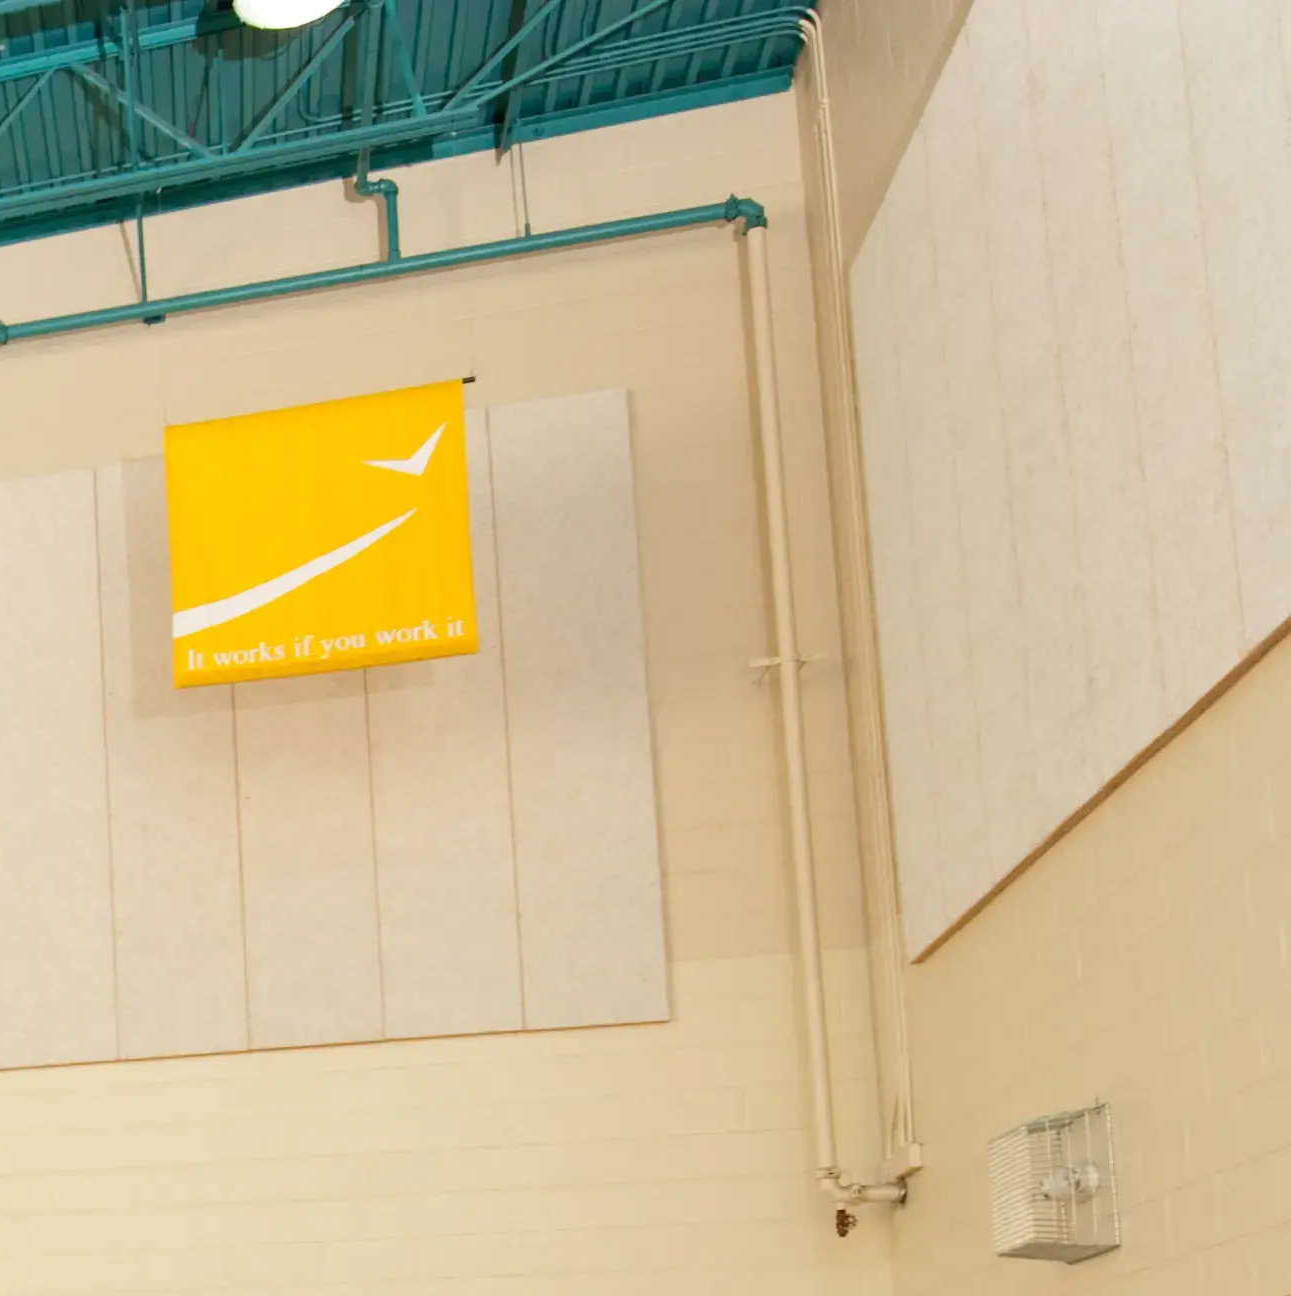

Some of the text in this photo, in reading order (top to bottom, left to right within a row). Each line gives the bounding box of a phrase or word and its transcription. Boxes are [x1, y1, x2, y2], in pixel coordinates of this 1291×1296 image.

[187, 616, 464, 670] It works if you work it
